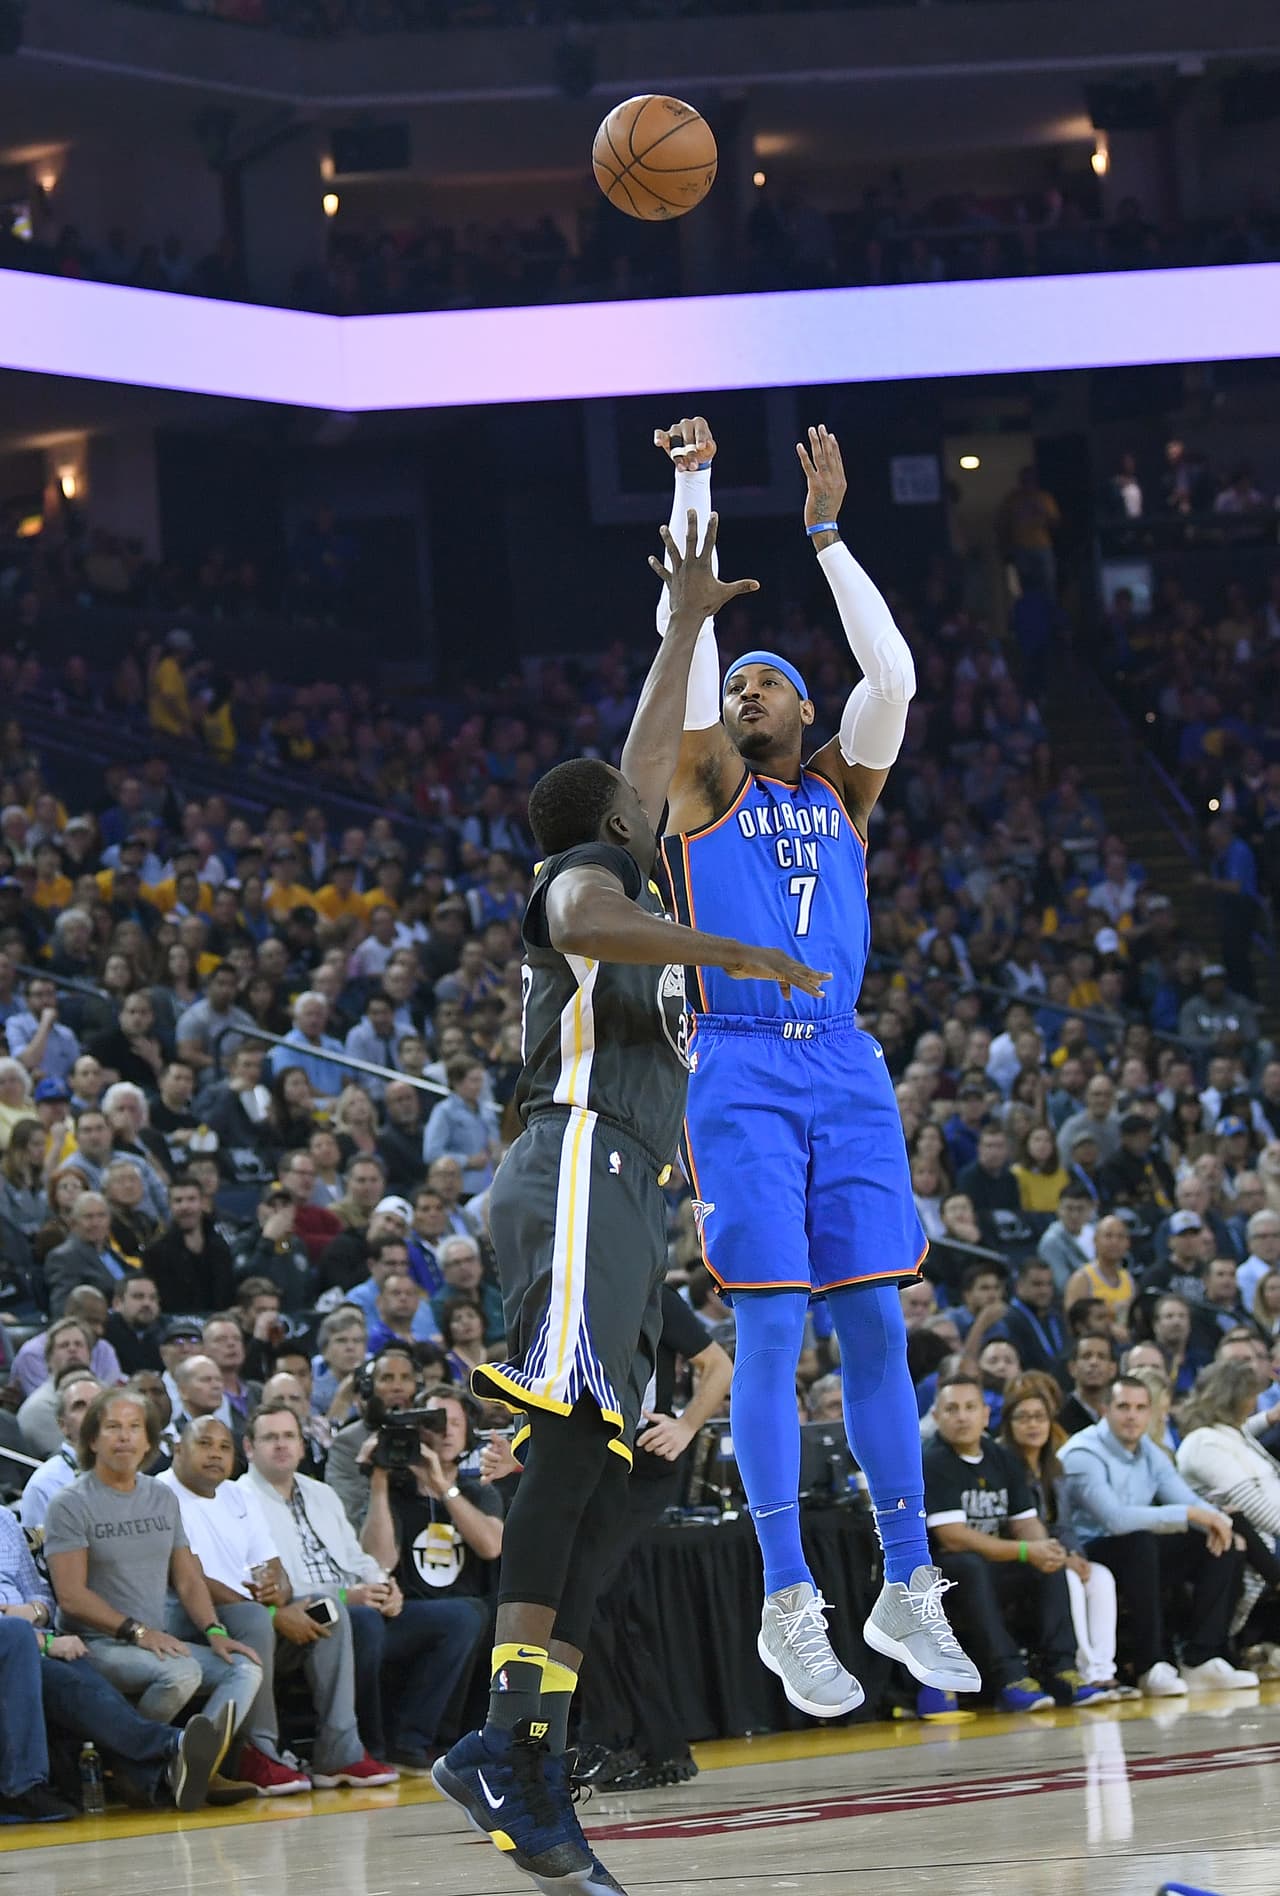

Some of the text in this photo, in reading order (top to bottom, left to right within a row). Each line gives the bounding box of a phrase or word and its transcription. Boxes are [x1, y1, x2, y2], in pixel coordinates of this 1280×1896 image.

[737, 802, 841, 840] OKLAOMA
[775, 838, 819, 871] CIY
[789, 875, 819, 936] 7
[783, 1022, 815, 1040] OKC
[95, 1515, 171, 1539] GRATEFUL
